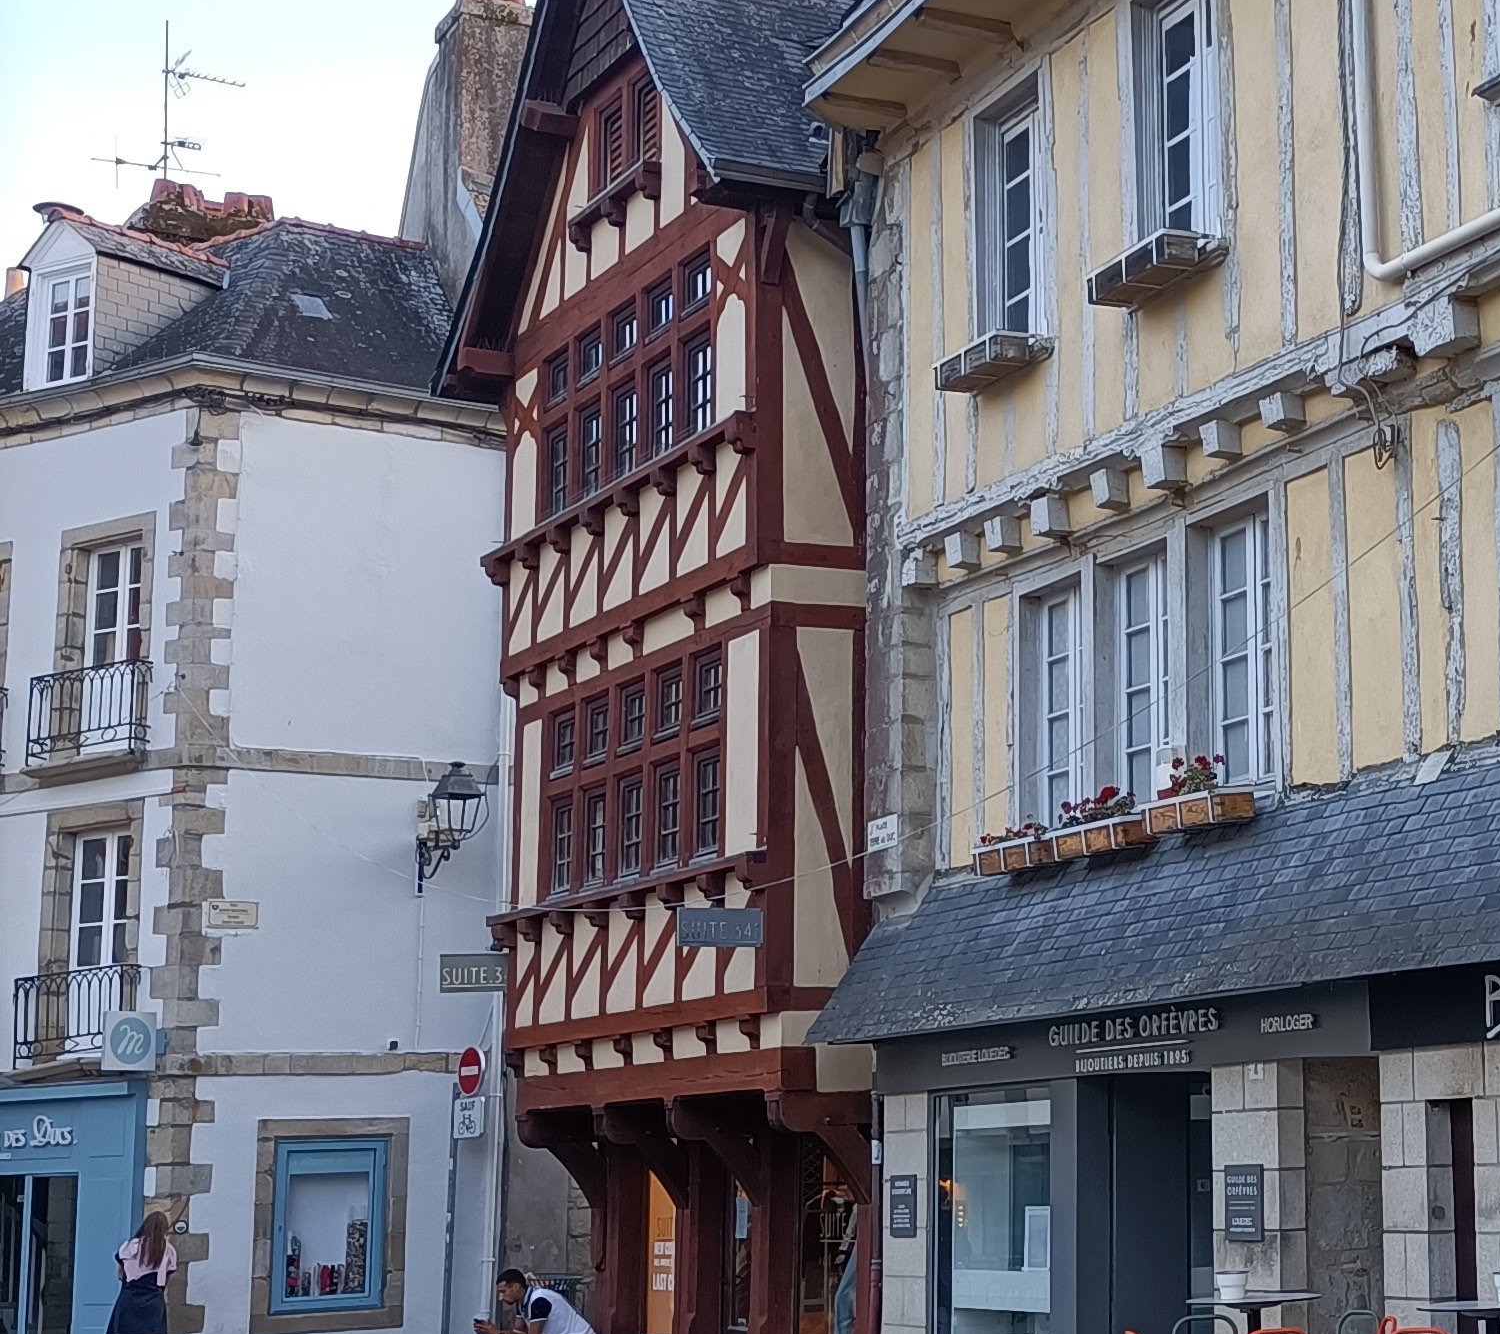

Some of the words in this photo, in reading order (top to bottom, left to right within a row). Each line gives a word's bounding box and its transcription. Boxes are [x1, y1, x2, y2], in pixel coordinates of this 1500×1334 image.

[442, 966, 506, 985] SUITE.3
[1048, 1020, 1100, 1047] GUILDE
[1105, 1017, 1134, 1041] DES
[1139, 1005, 1219, 1037] ORFÈVRES
[1260, 1013, 1315, 1035] HORLOGER
[1075, 1055, 1126, 1073] BIJOUTIERS
[1127, 1052, 1161, 1068] DEPUIS
[1163, 1049, 1190, 1065] 1895
[460, 1100, 476, 1112] SAUF
[4, 1129, 27, 1148] DES
